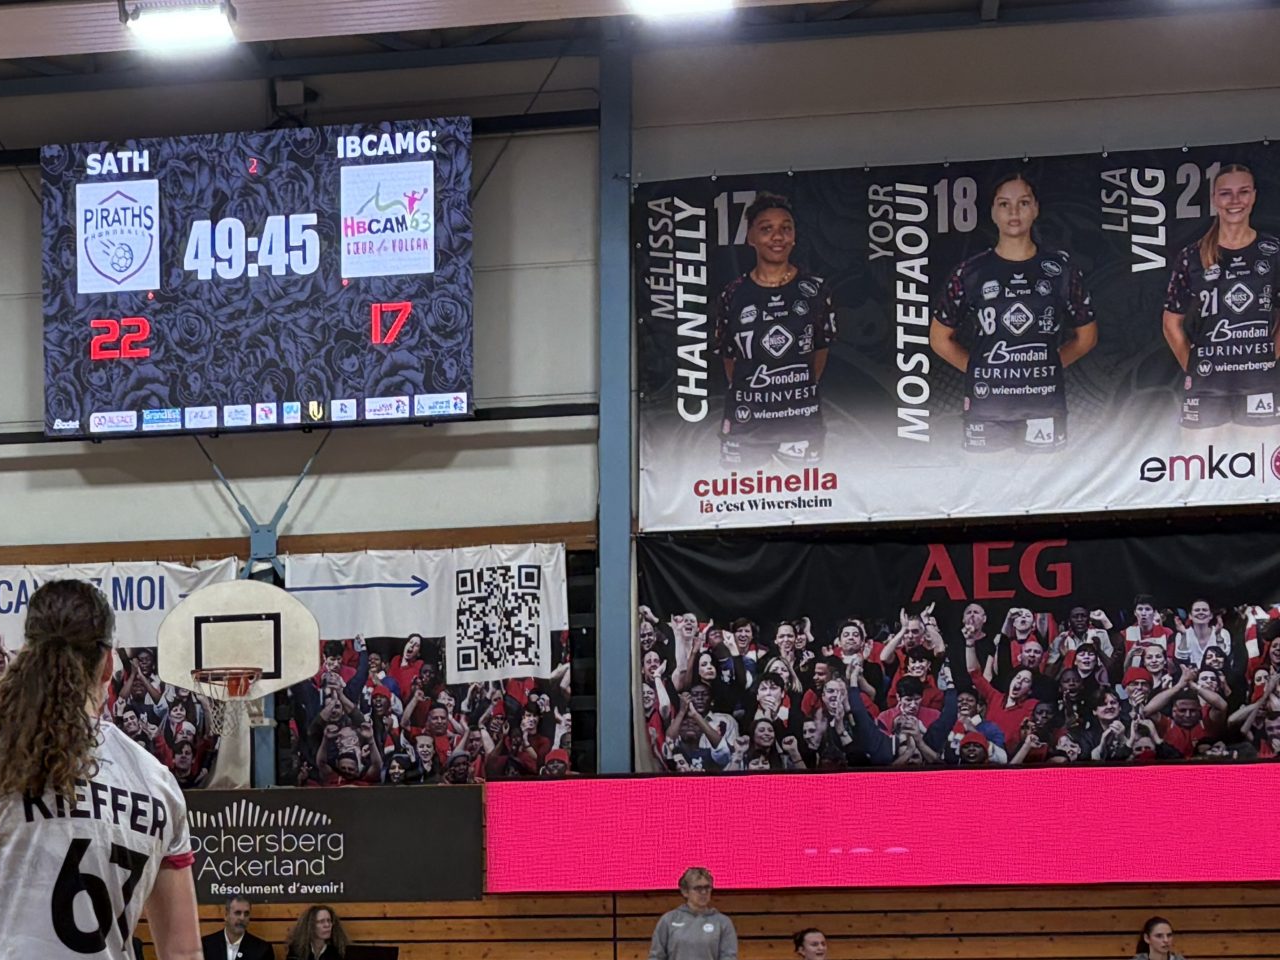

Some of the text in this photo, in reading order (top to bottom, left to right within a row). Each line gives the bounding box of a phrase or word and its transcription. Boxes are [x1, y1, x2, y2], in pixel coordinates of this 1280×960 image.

[86, 150, 150, 175] SATH
[933, 177, 978, 233] 18
[1100, 168, 1128, 232] LISA
[84, 205, 154, 234] PIRATHS
[714, 190, 756, 246] 17
[868, 184, 894, 260] YOSR
[1130, 168, 1166, 273] VLUG
[183, 213, 321, 281] 49:45
[645, 197, 675, 320] MÉLISSA
[674, 196, 708, 422] CHANTELLY
[895, 183, 930, 442] MOSTEFAOUI
[1199, 287, 1218, 318] 21
[90, 317, 150, 360] 22
[371, 302, 412, 344] 17
[1206, 319, 1268, 342] Brondani
[983, 341, 1048, 364] Brondani
[1197, 343, 1275, 357] EURINVEST
[746, 364, 810, 388] Brondani
[974, 366, 1056, 379] EURINVEST
[1215, 360, 1276, 373] wienerberger
[735, 384, 818, 402] EURINVEST
[992, 385, 1056, 396] wienerberger
[1255, 398, 1272, 411] As
[753, 405, 819, 418] wienerberger
[1033, 428, 1052, 441] As
[1139, 445, 1255, 483] emka
[693, 468, 838, 497] cuisinella
[700, 496, 832, 513] là c'est Wiwersheim
[912, 538, 1073, 602] AEG
[112, 575, 165, 612] MOI
[22, 779, 167, 842] KIEFFER
[190, 827, 344, 861] ochersberg
[197, 854, 326, 881] Ackerland
[51, 838, 150, 955] 67
[210, 880, 344, 896] Résolument d'avenir!
